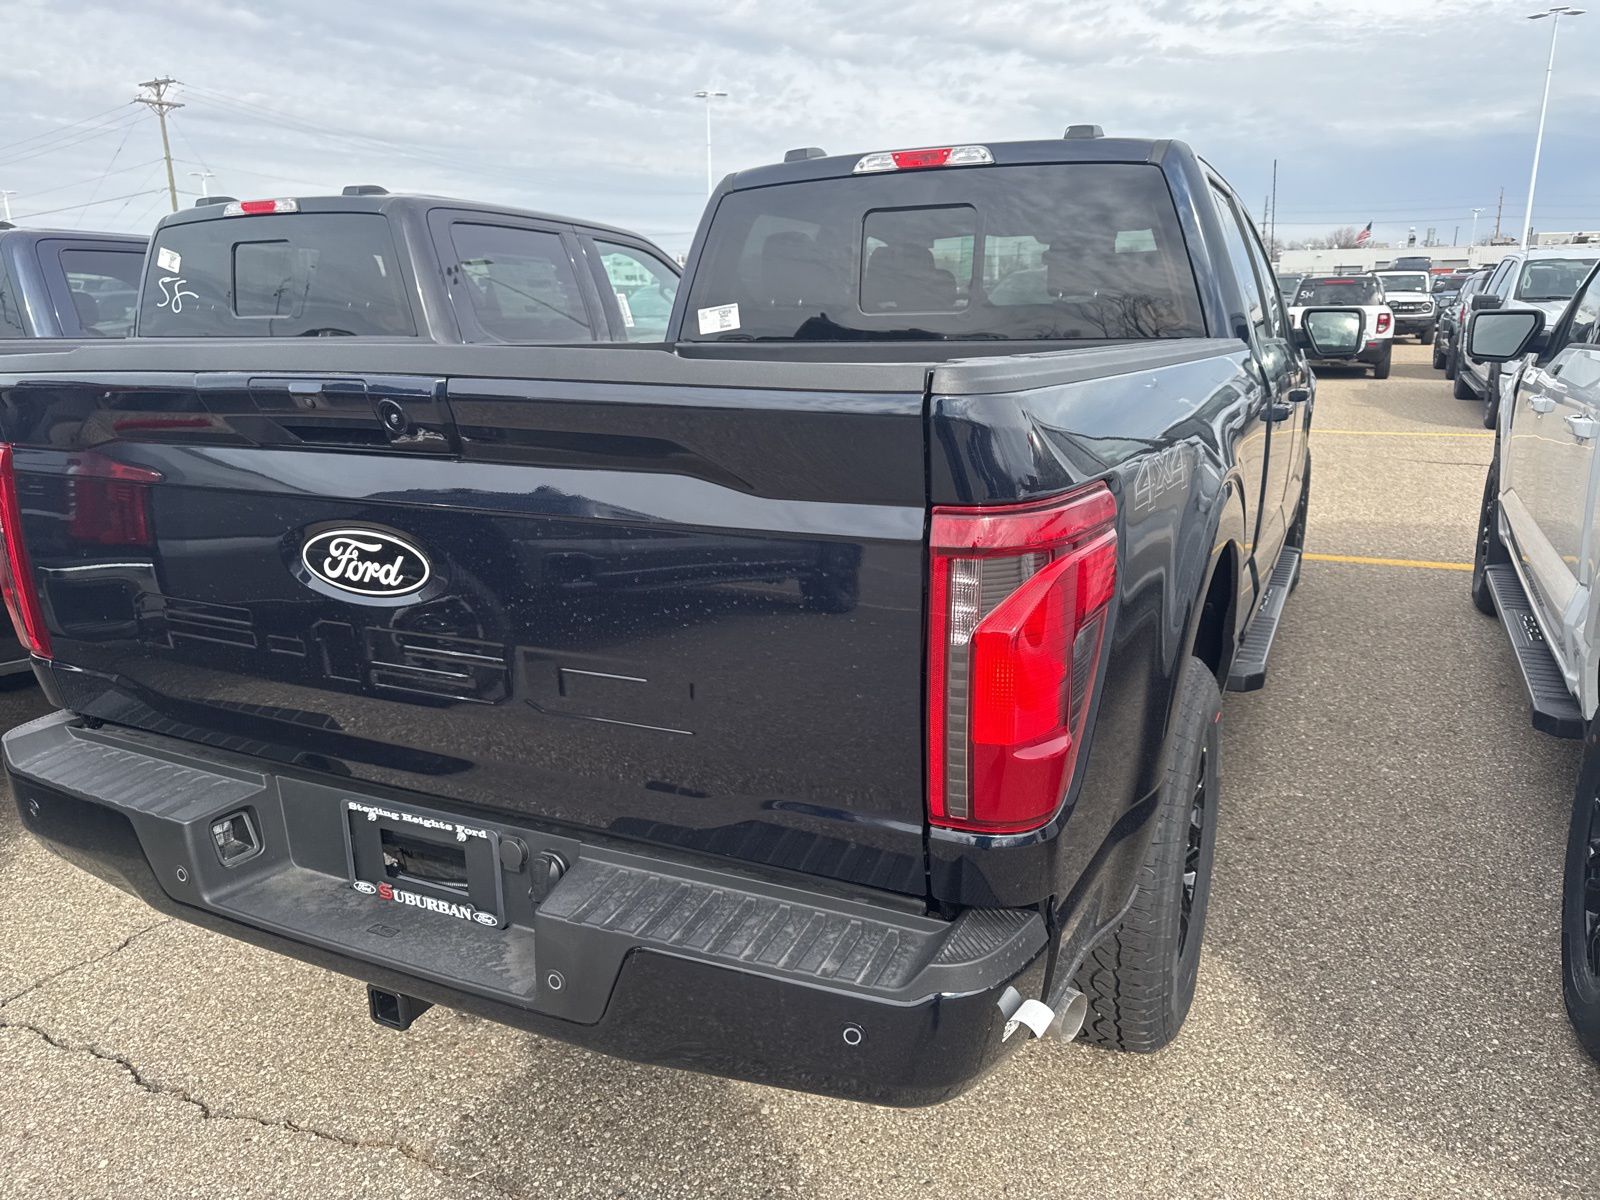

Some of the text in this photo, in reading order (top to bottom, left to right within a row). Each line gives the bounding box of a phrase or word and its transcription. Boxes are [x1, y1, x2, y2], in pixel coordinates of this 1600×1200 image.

[323, 537, 404, 586] Ford
[348, 801, 487, 839] Sterling Heights Ford
[378, 883, 471, 920] SUBURBAN
